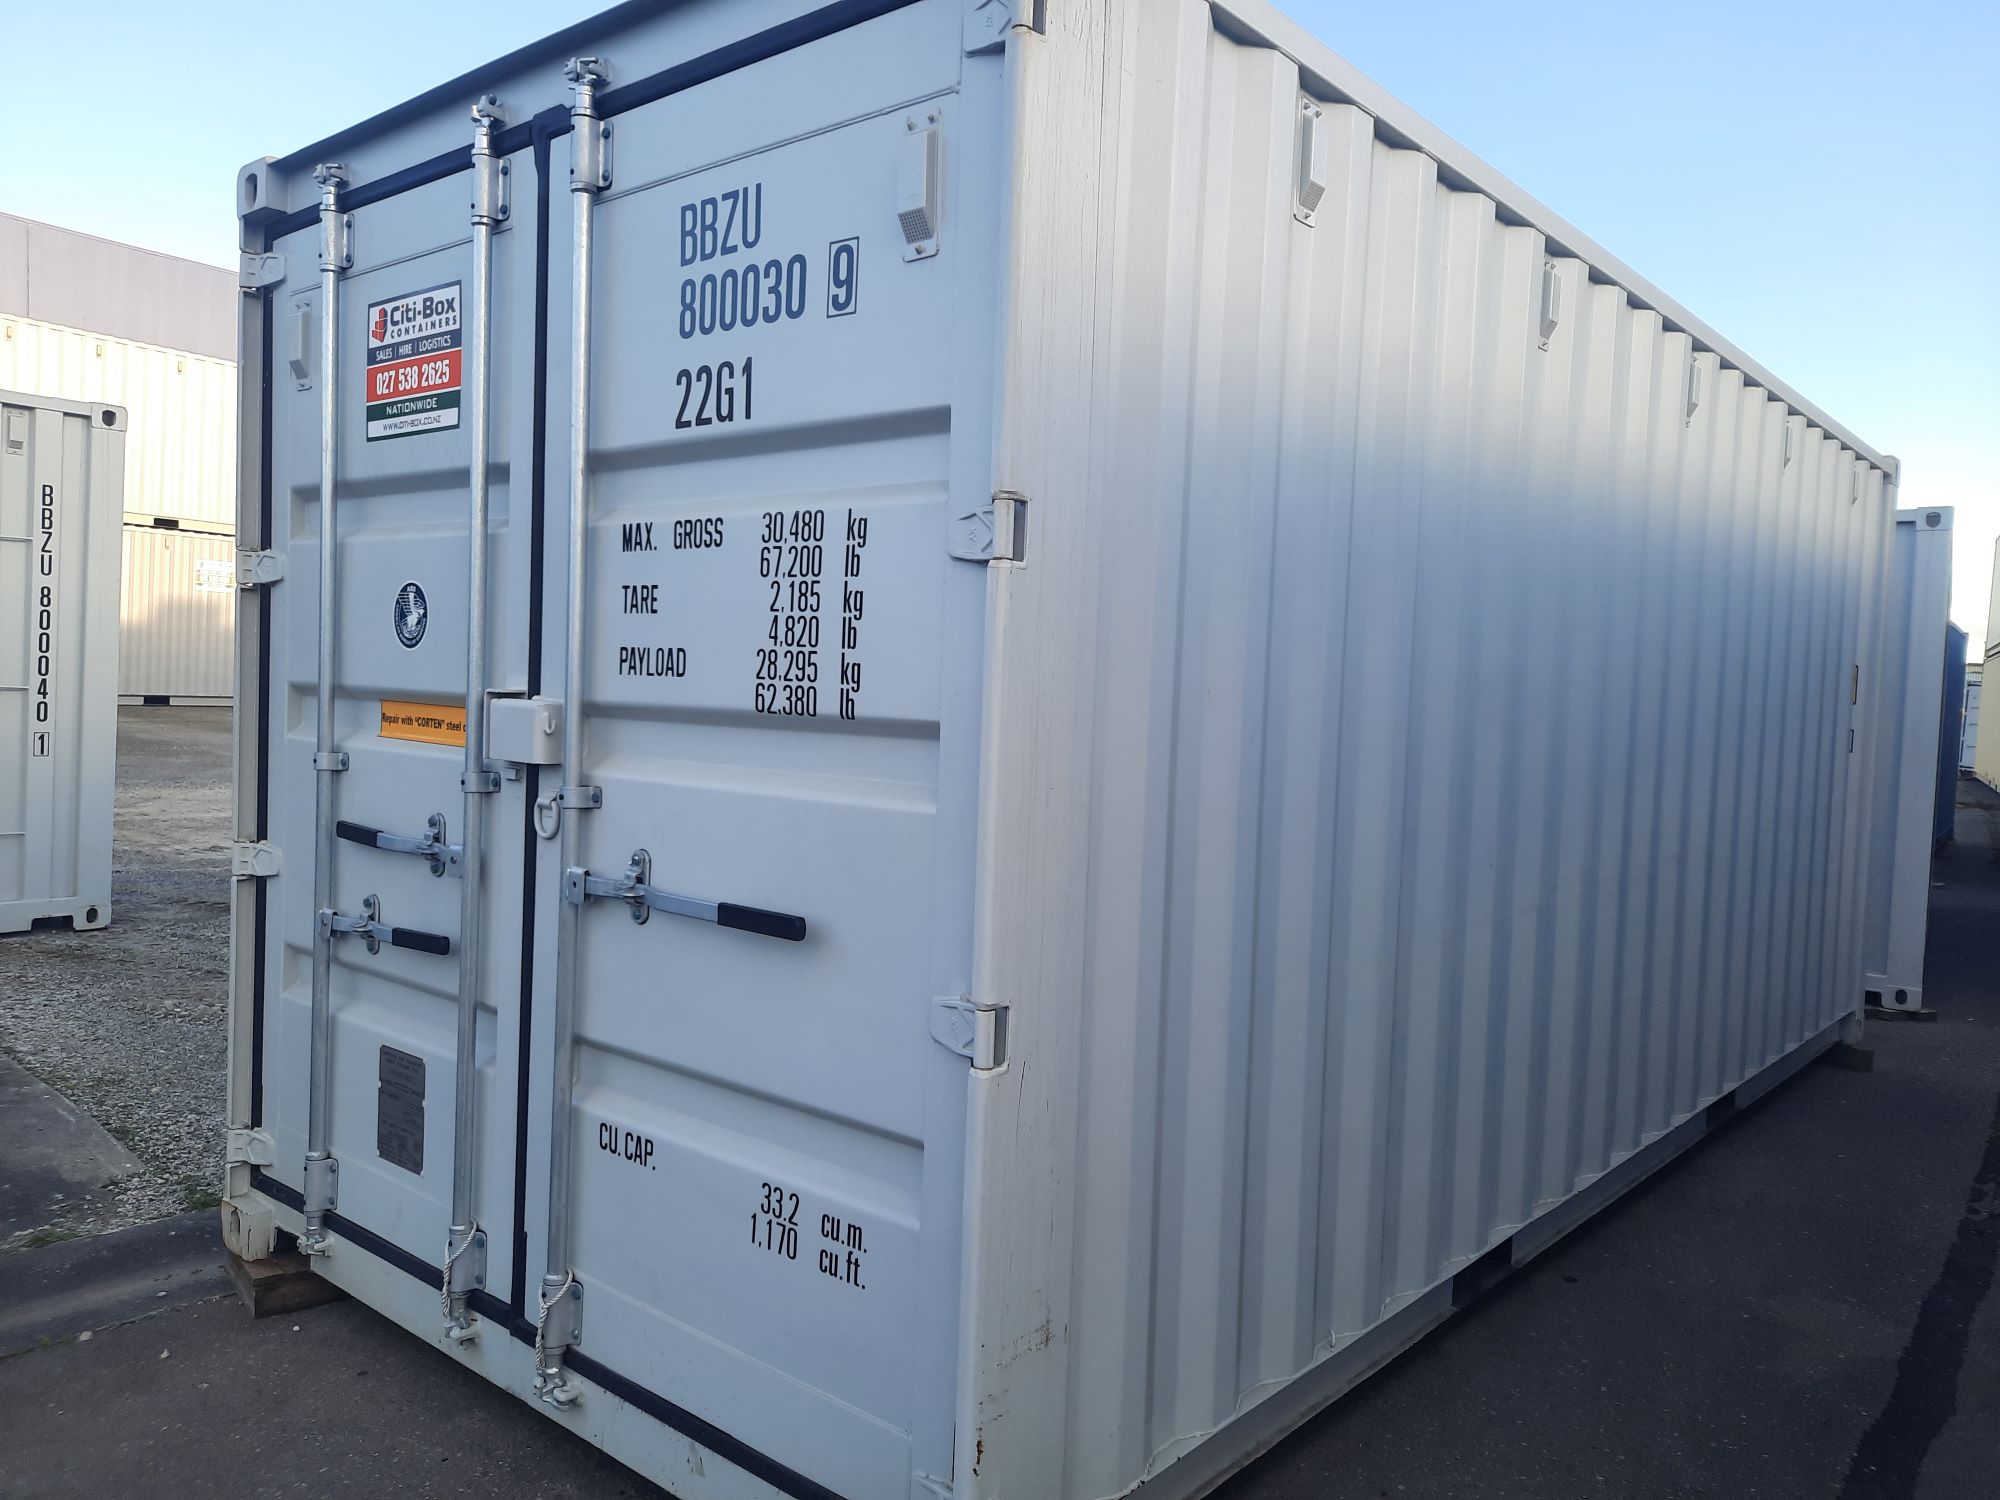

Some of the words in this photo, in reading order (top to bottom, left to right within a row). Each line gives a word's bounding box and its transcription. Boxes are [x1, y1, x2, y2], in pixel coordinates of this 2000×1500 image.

[680, 182, 762, 267] BBZU
[390, 296, 457, 327] Citi-Box
[679, 253, 807, 340] 800030
[831, 243, 855, 312] 9
[390, 315, 457, 339] CONTAINERS
[376, 347, 393, 361] SALES
[398, 343, 413, 356] HIRE
[418, 335, 451, 352] LOGISTICS
[376, 370, 396, 395] 027
[398, 365, 419, 391] 538
[421, 359, 450, 387] 2625
[675, 356, 752, 429] 22G1
[386, 397, 438, 416] NATIONWIDE
[40, 484, 54, 577] BBZU
[622, 521, 658, 553] MAX.
[673, 517, 724, 550] GROSS
[761, 509, 825, 545] 30,480
[846, 507, 868, 548] kg
[760, 544, 823, 579] 67,200
[845, 544, 861, 578] lb
[622, 585, 659, 614] TARE
[769, 580, 821, 613] 2,185
[843, 580, 864, 621] kg
[768, 615, 820, 648] 4,820
[841, 616, 857, 650] lb
[36, 585, 52, 723] 800040
[619, 646, 687, 678] PAYLOAD
[755, 648, 818, 683] 28,295
[840, 652, 861, 693] kg
[755, 682, 817, 718] 62,380
[382, 712, 400, 725] Repair
[401, 715, 413, 726] with
[446, 719, 461, 732] steel
[760, 1182, 800, 1227] 33.2
[821, 1213, 868, 1254] cu.m.
[751, 1212, 798, 1261] 1,170
[819, 1248, 866, 1290] cu.ft.
